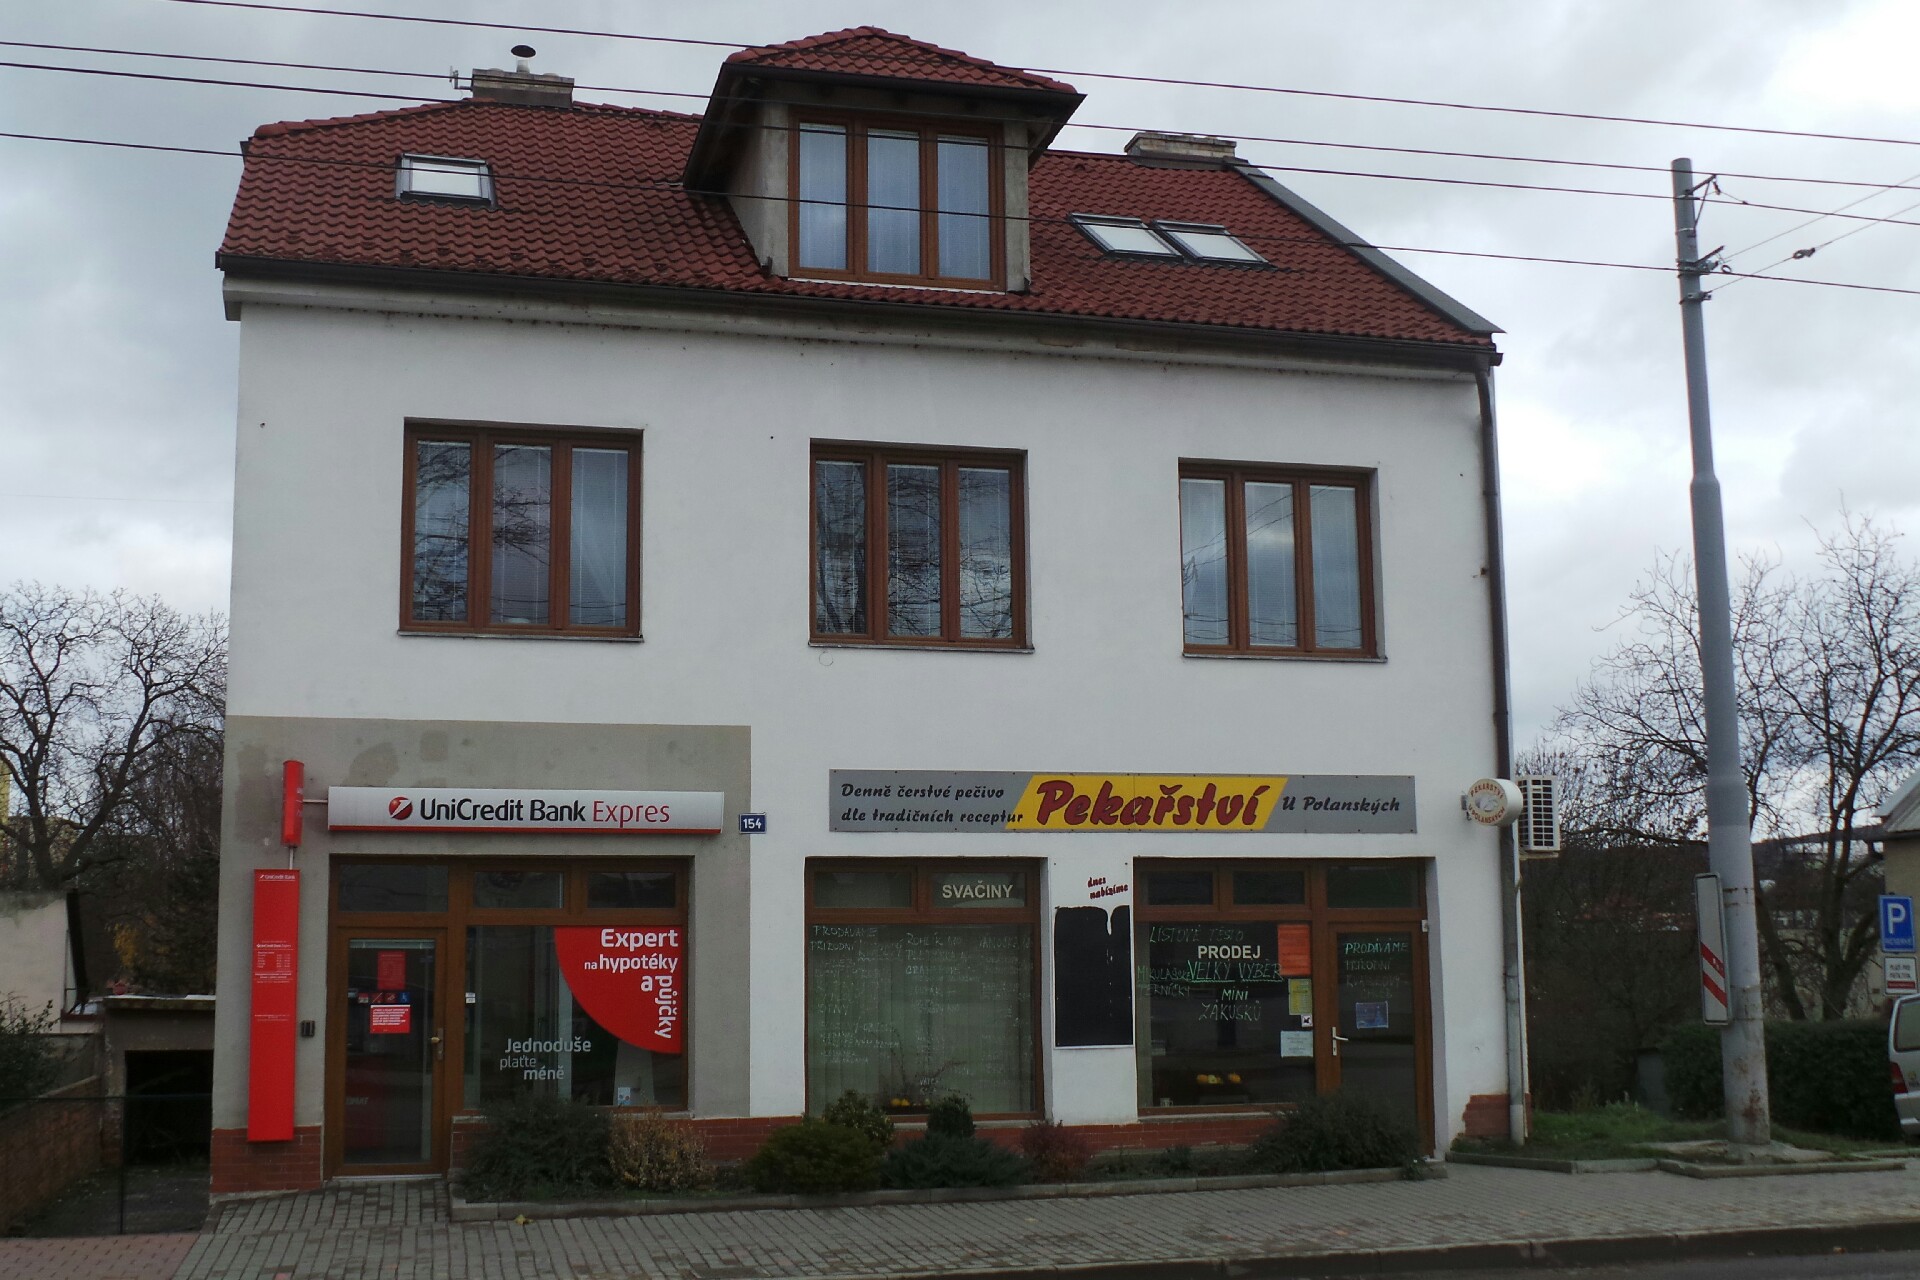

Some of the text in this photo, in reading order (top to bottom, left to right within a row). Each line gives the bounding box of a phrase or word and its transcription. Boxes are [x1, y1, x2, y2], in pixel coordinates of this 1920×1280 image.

[841, 783, 1005, 801] Denně čerstvé pečivo
[1036, 779, 1271, 826] Pekařství
[1282, 796, 1401, 816] U Polanských
[420, 798, 670, 829] UniCredit Bank Expres
[841, 807, 1024, 826] dle tradičních receptur
[743, 818, 763, 830] 154
[942, 879, 1014, 899] SVAČINY
[1087, 876, 1107, 888] dnes
[1089, 883, 1129, 900] nabízíme
[1887, 902, 1907, 935] P
[600, 928, 679, 952] Expert
[1197, 945, 1261, 959] PRODEJ
[584, 952, 679, 974] na hypotéky
[640, 975, 653, 992] a
[654, 975, 678, 1039] půjčky
[504, 1036, 592, 1053] Jednoduše
[500, 1054, 537, 1071] plaťte
[523, 1065, 565, 1080] méně
